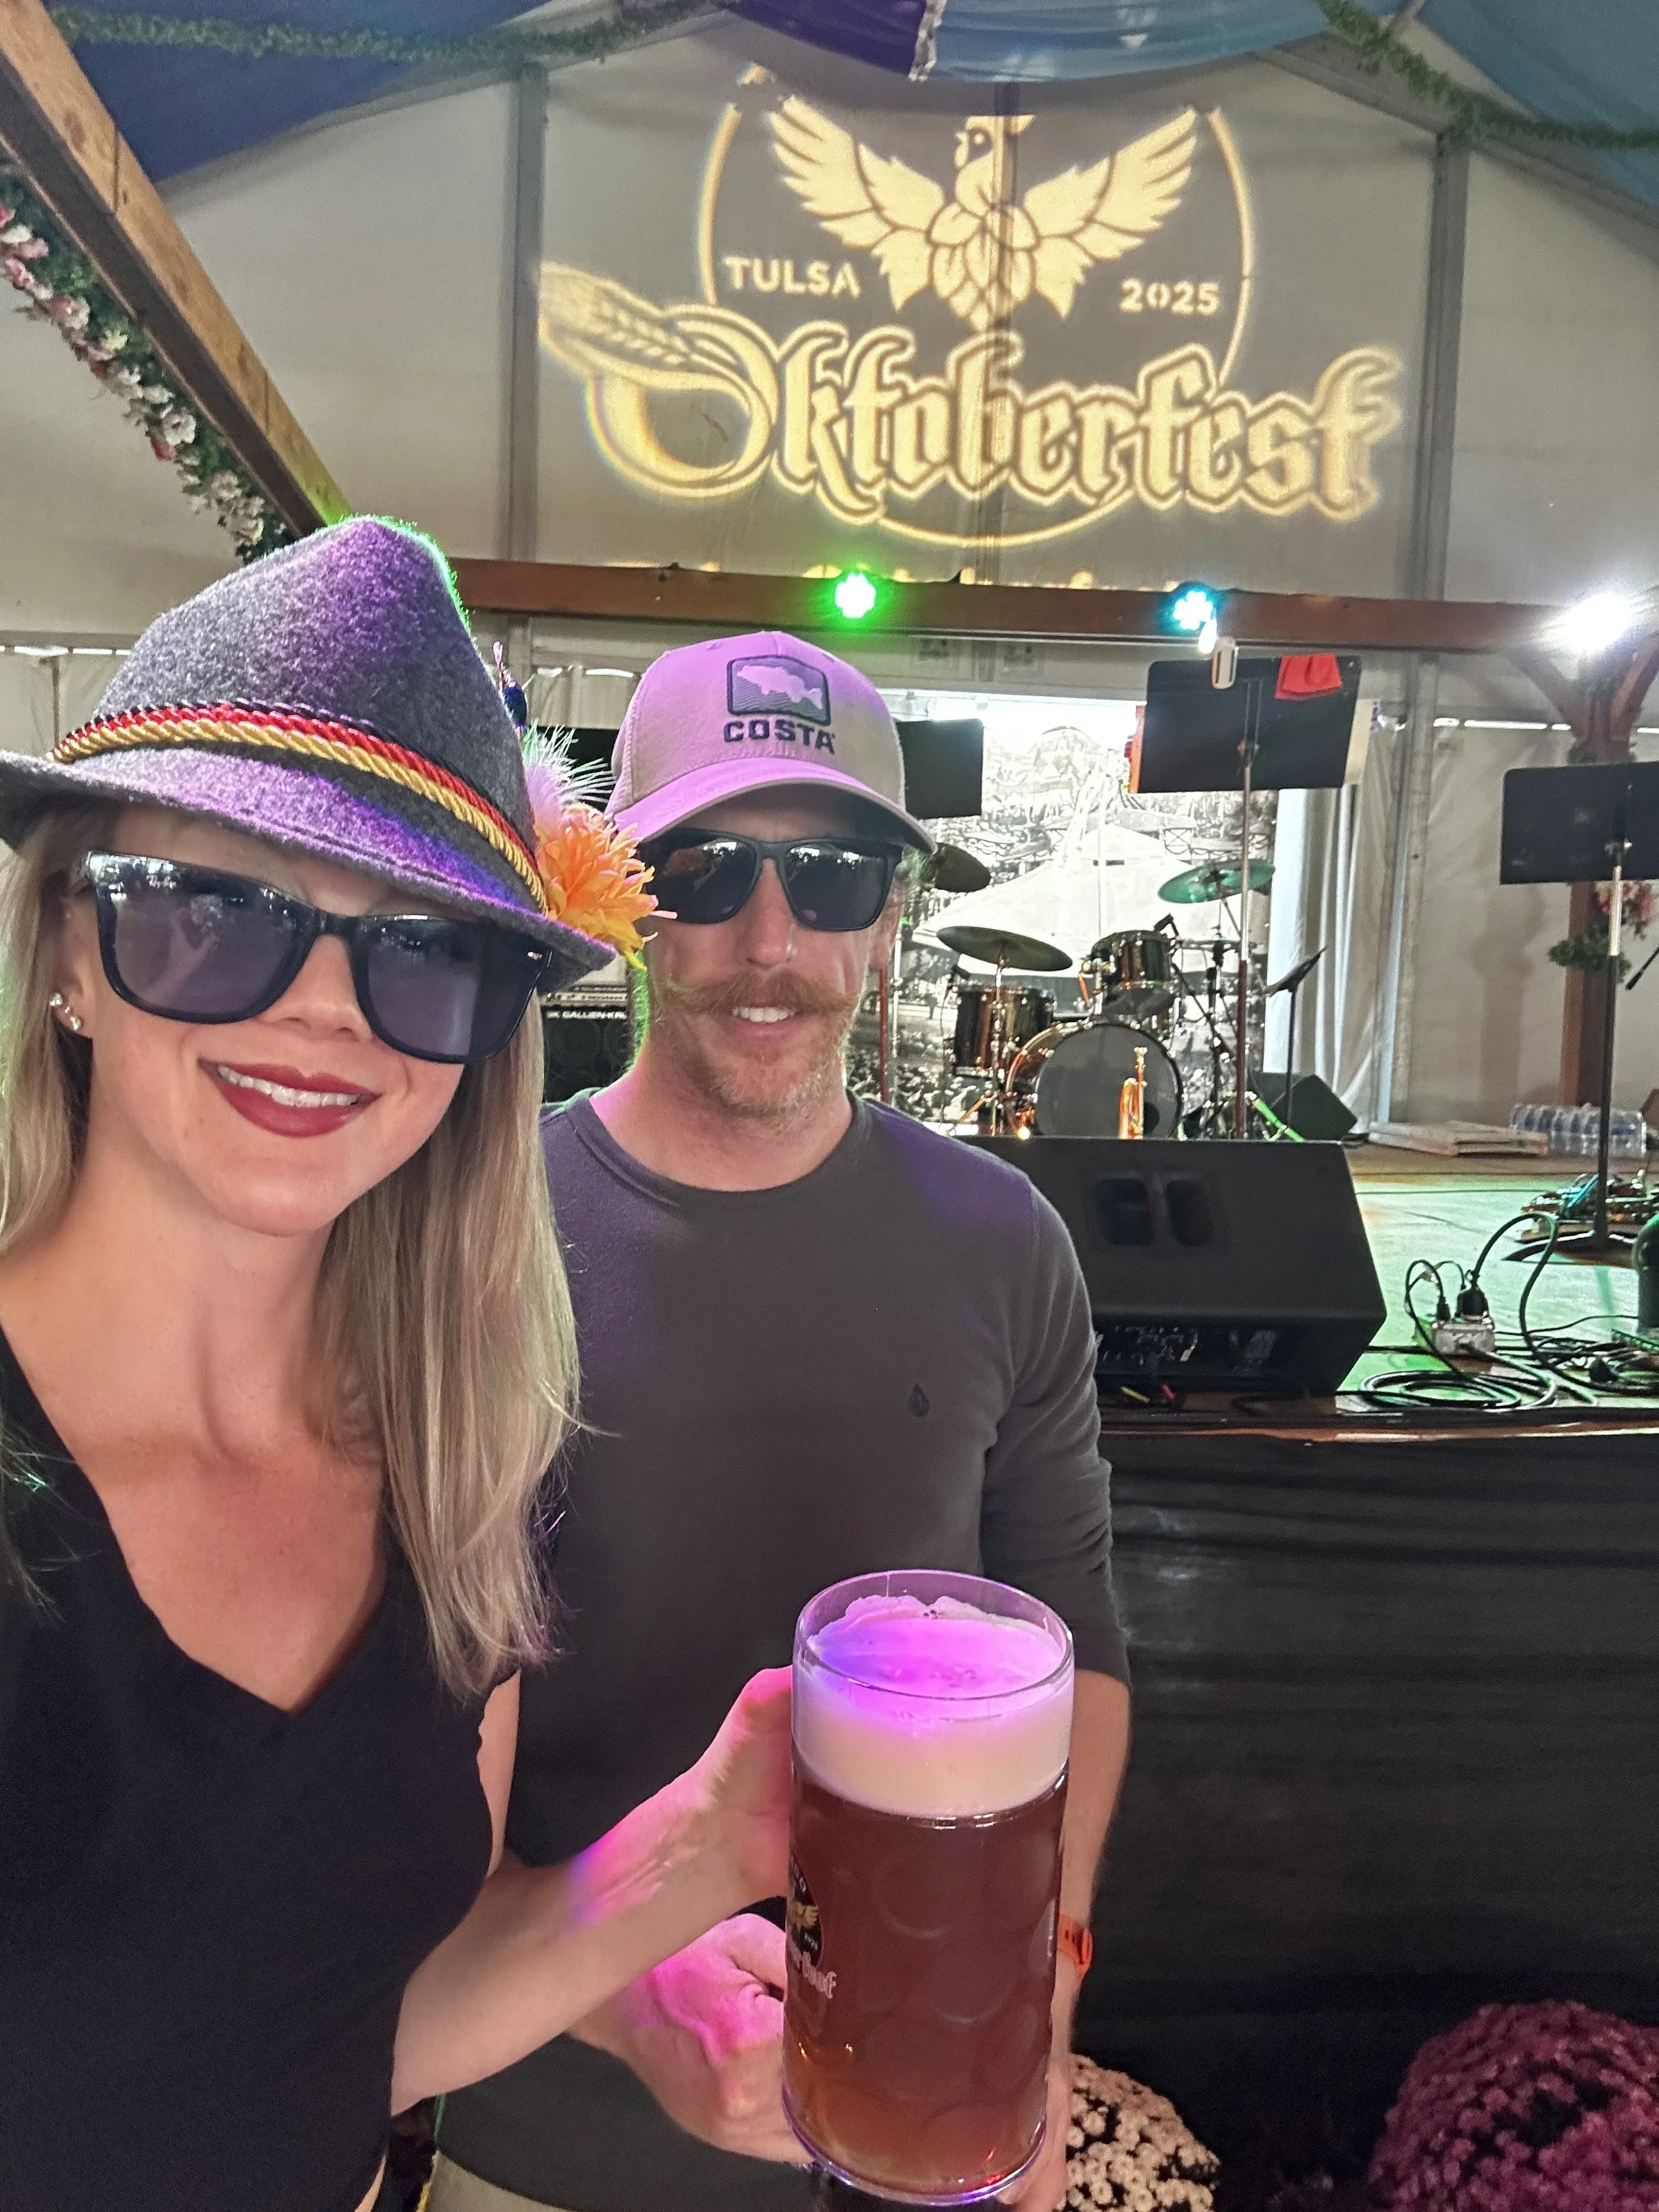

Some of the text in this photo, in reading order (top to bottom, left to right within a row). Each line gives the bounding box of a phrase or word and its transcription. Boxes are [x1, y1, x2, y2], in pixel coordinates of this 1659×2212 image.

[724, 255, 861, 298] TULSA
[1119, 277, 1221, 316] 2025
[541, 263, 1403, 519] Oktoberfest
[724, 719, 835, 755] COSTA
